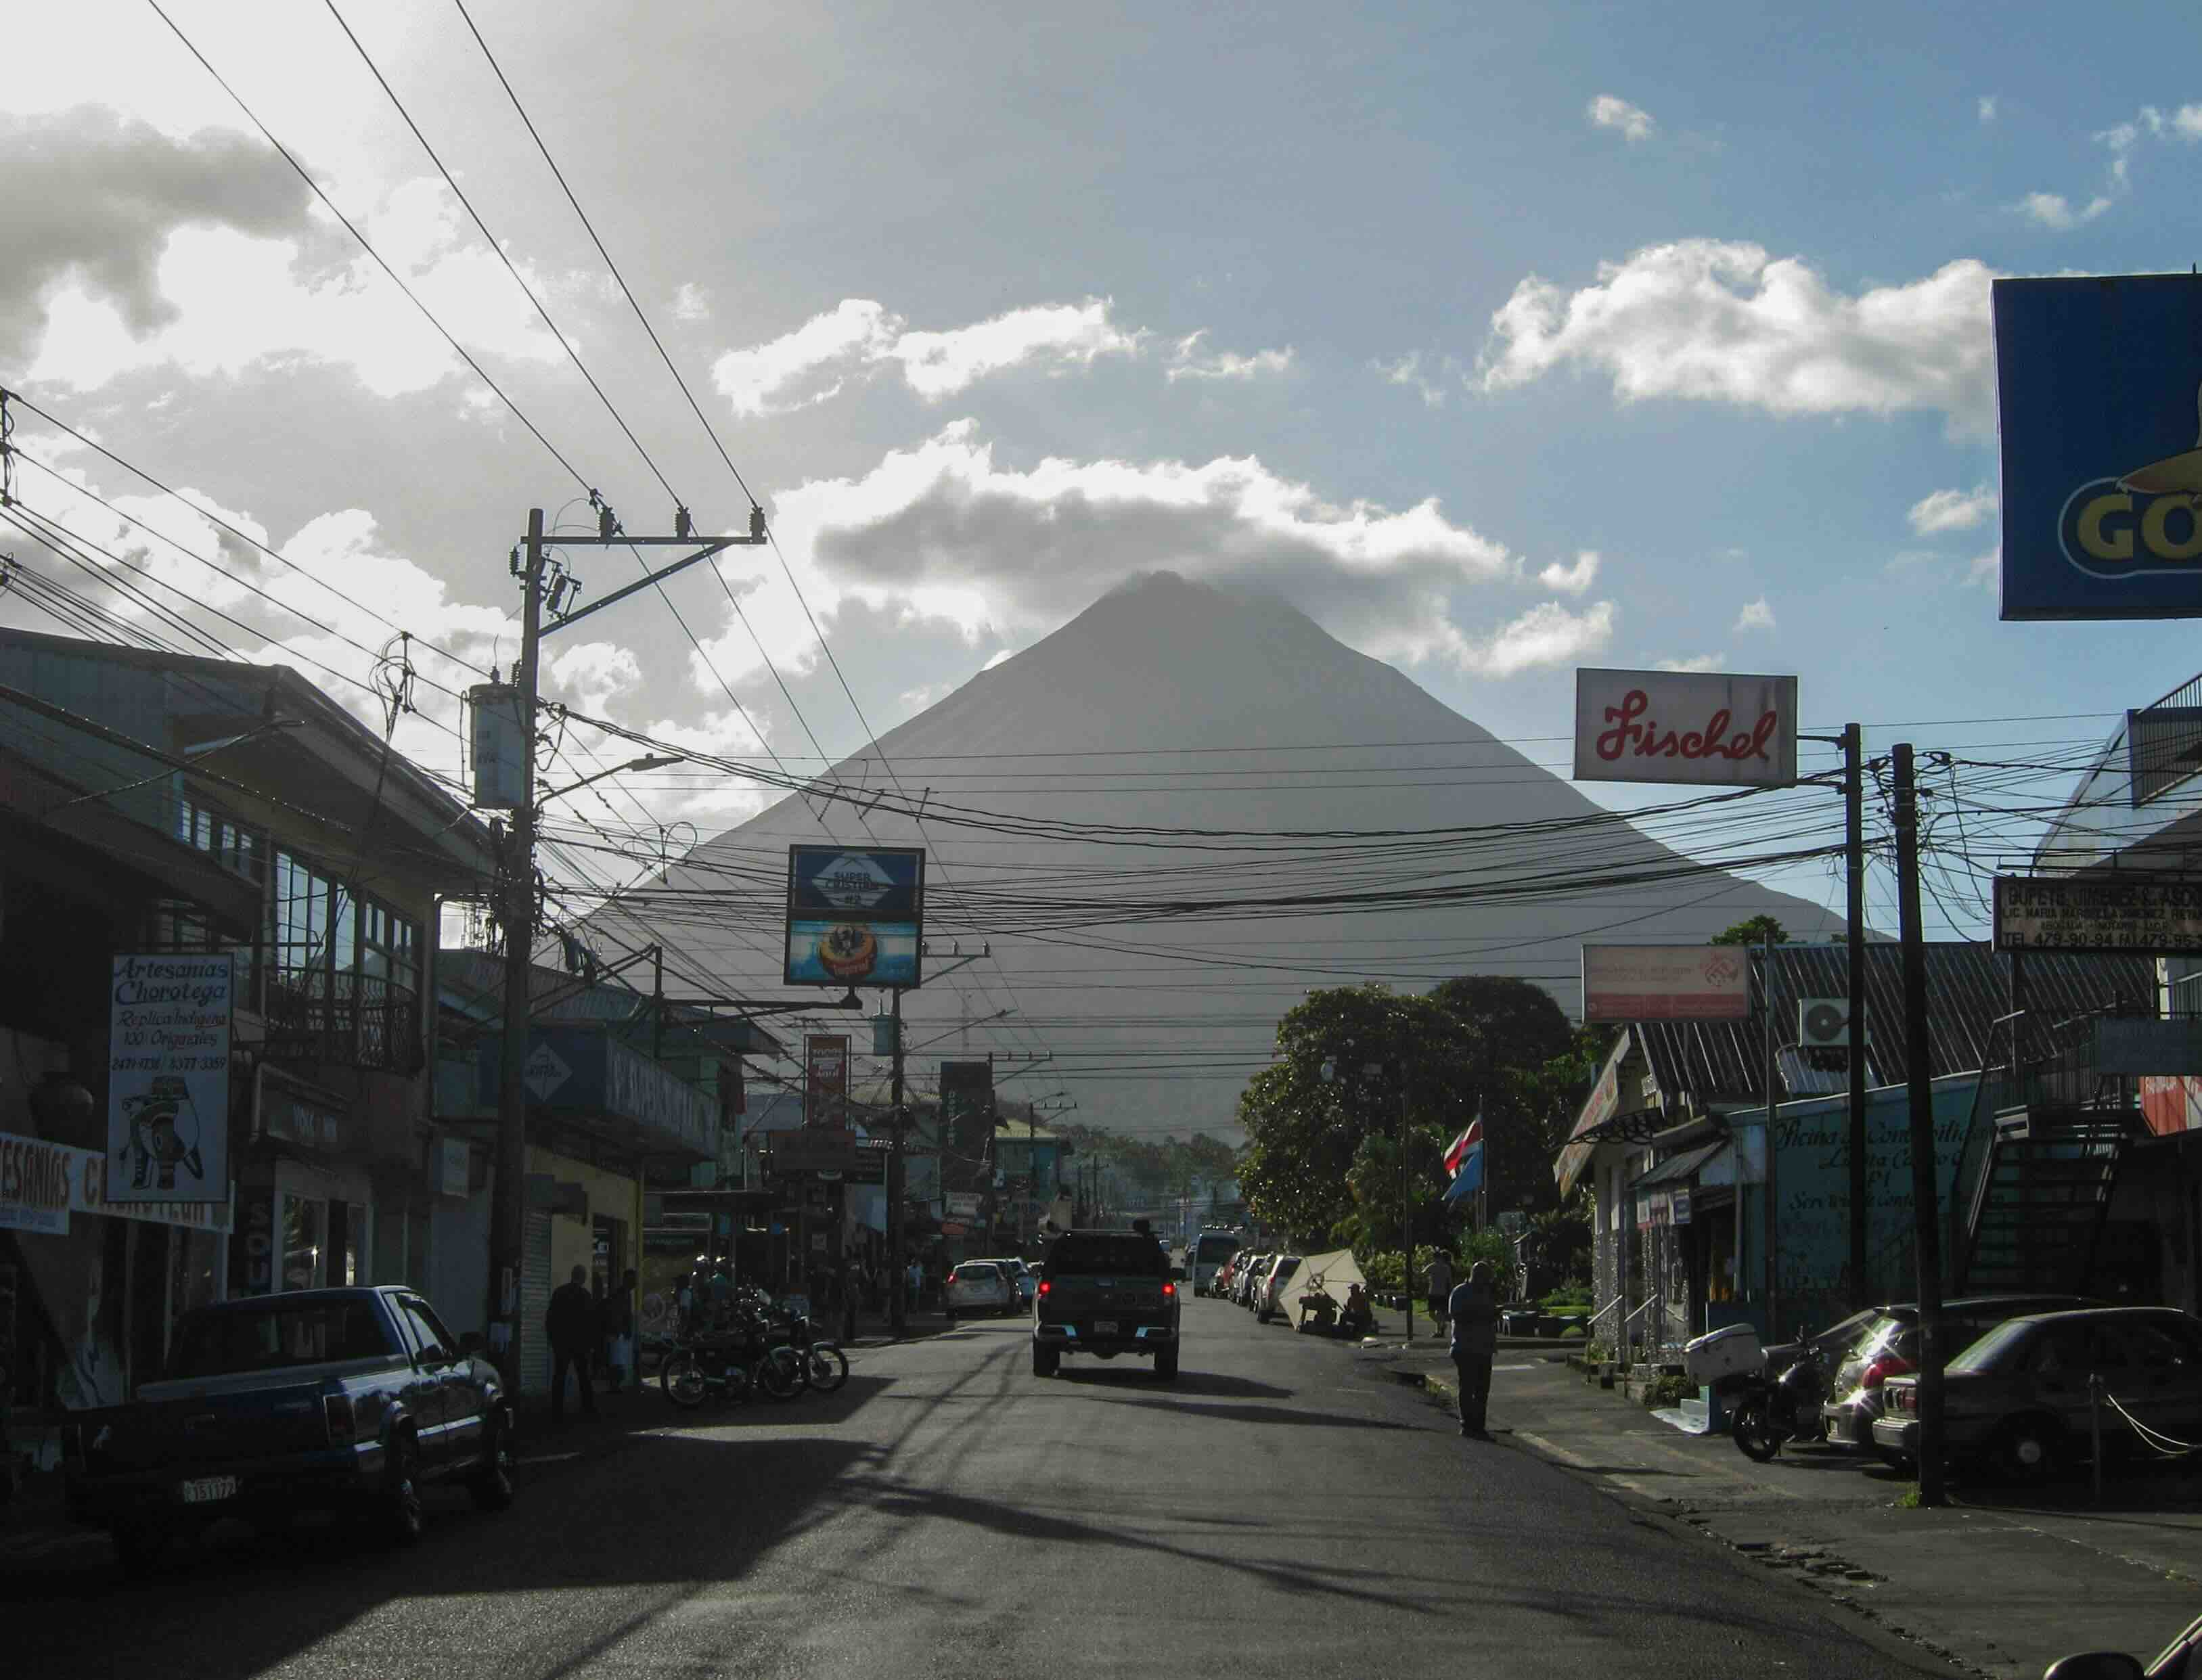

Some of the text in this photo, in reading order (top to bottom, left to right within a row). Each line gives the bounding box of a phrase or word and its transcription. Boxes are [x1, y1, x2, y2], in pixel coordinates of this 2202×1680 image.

[1596, 689, 1777, 761] Fischel
[114, 980, 227, 1007] Chorotega
[0, 1137, 71, 1208] ESANIAS
